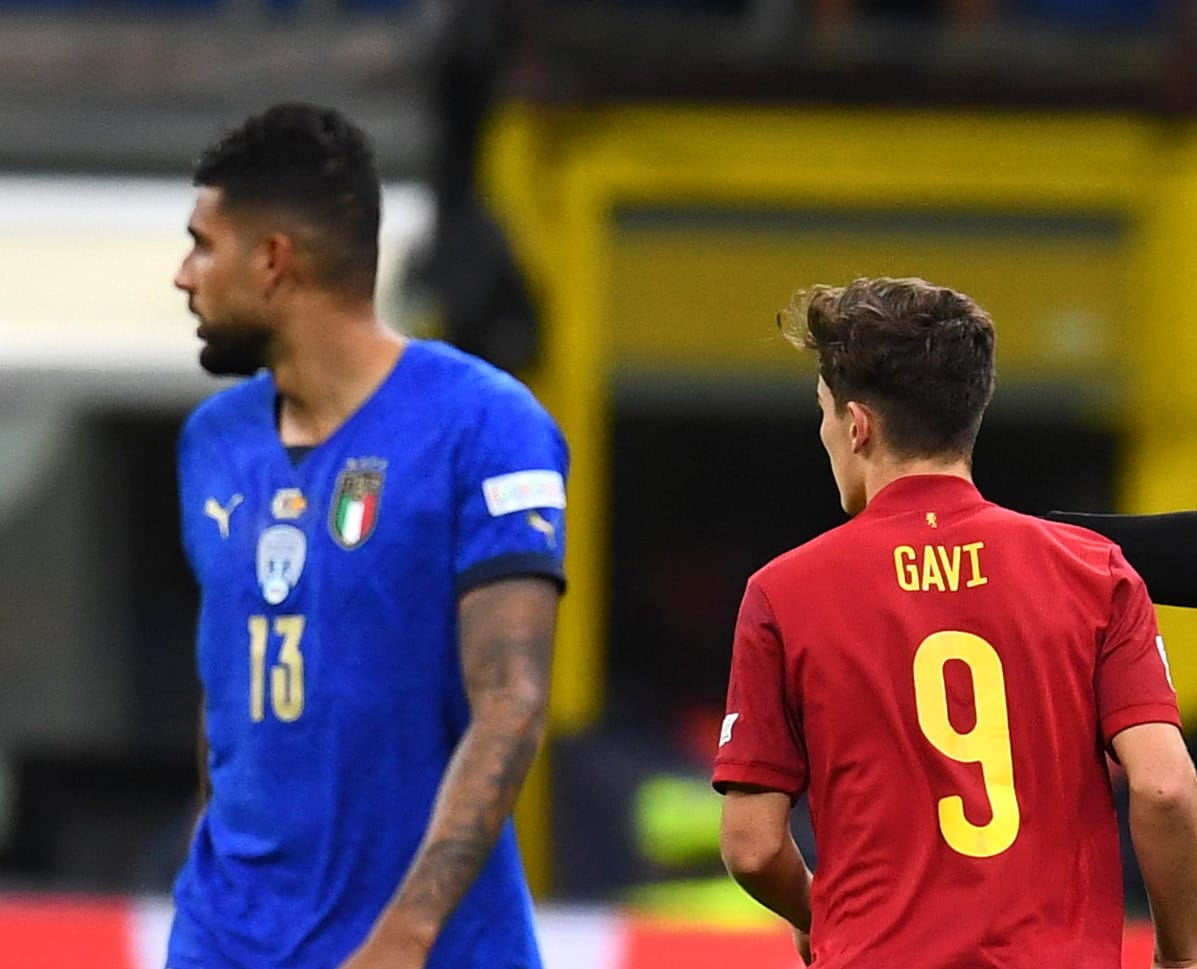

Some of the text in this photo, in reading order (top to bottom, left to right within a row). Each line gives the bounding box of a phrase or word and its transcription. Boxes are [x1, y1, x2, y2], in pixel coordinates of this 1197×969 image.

[894, 542, 987, 591] GAVI
[248, 615, 305, 722] 13
[913, 631, 1020, 857] 9
